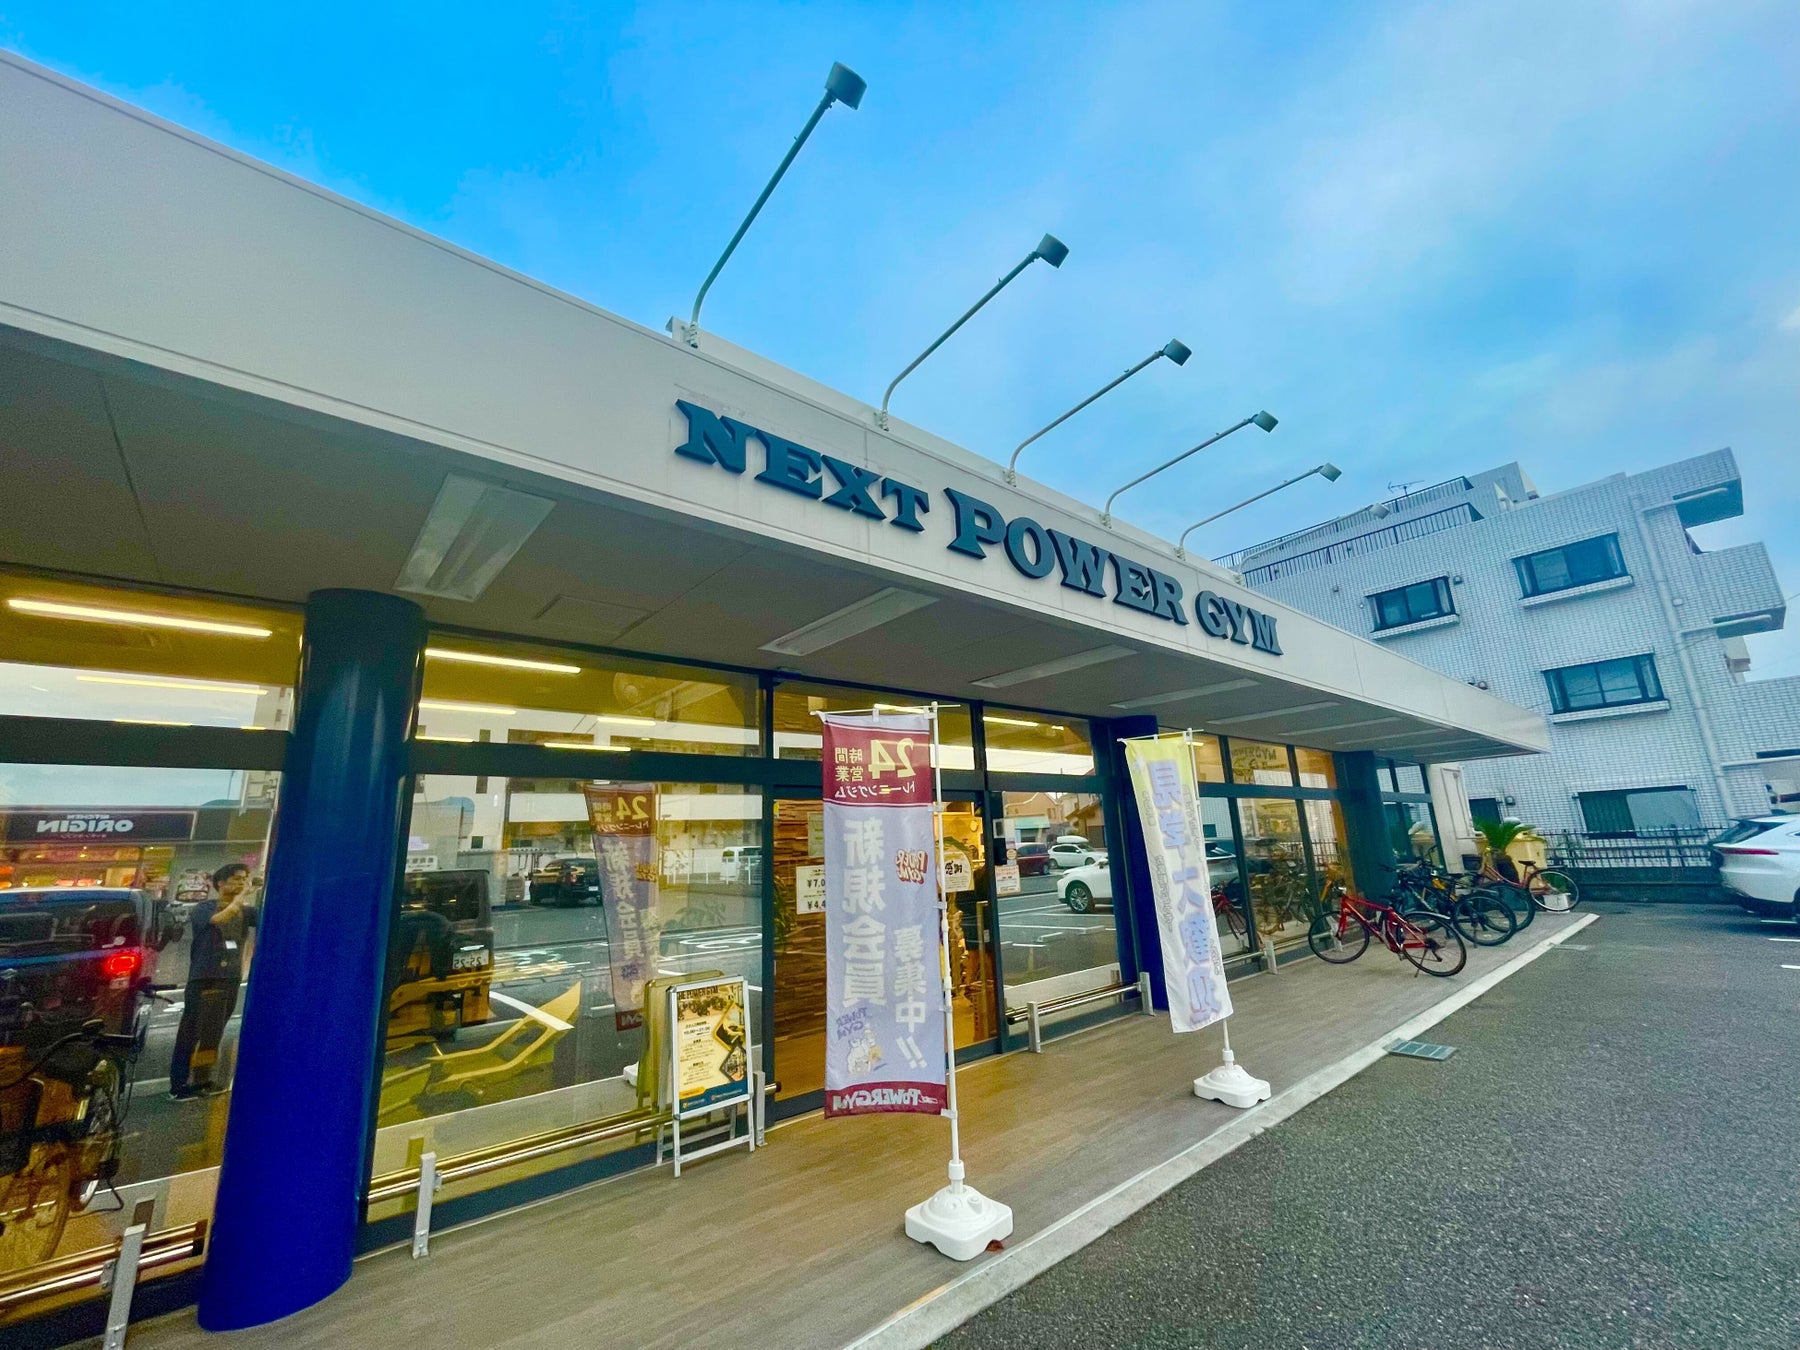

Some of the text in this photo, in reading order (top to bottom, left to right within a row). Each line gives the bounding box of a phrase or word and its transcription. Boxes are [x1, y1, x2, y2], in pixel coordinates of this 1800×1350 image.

[674, 398, 1284, 656] NEXT POWER GYM
